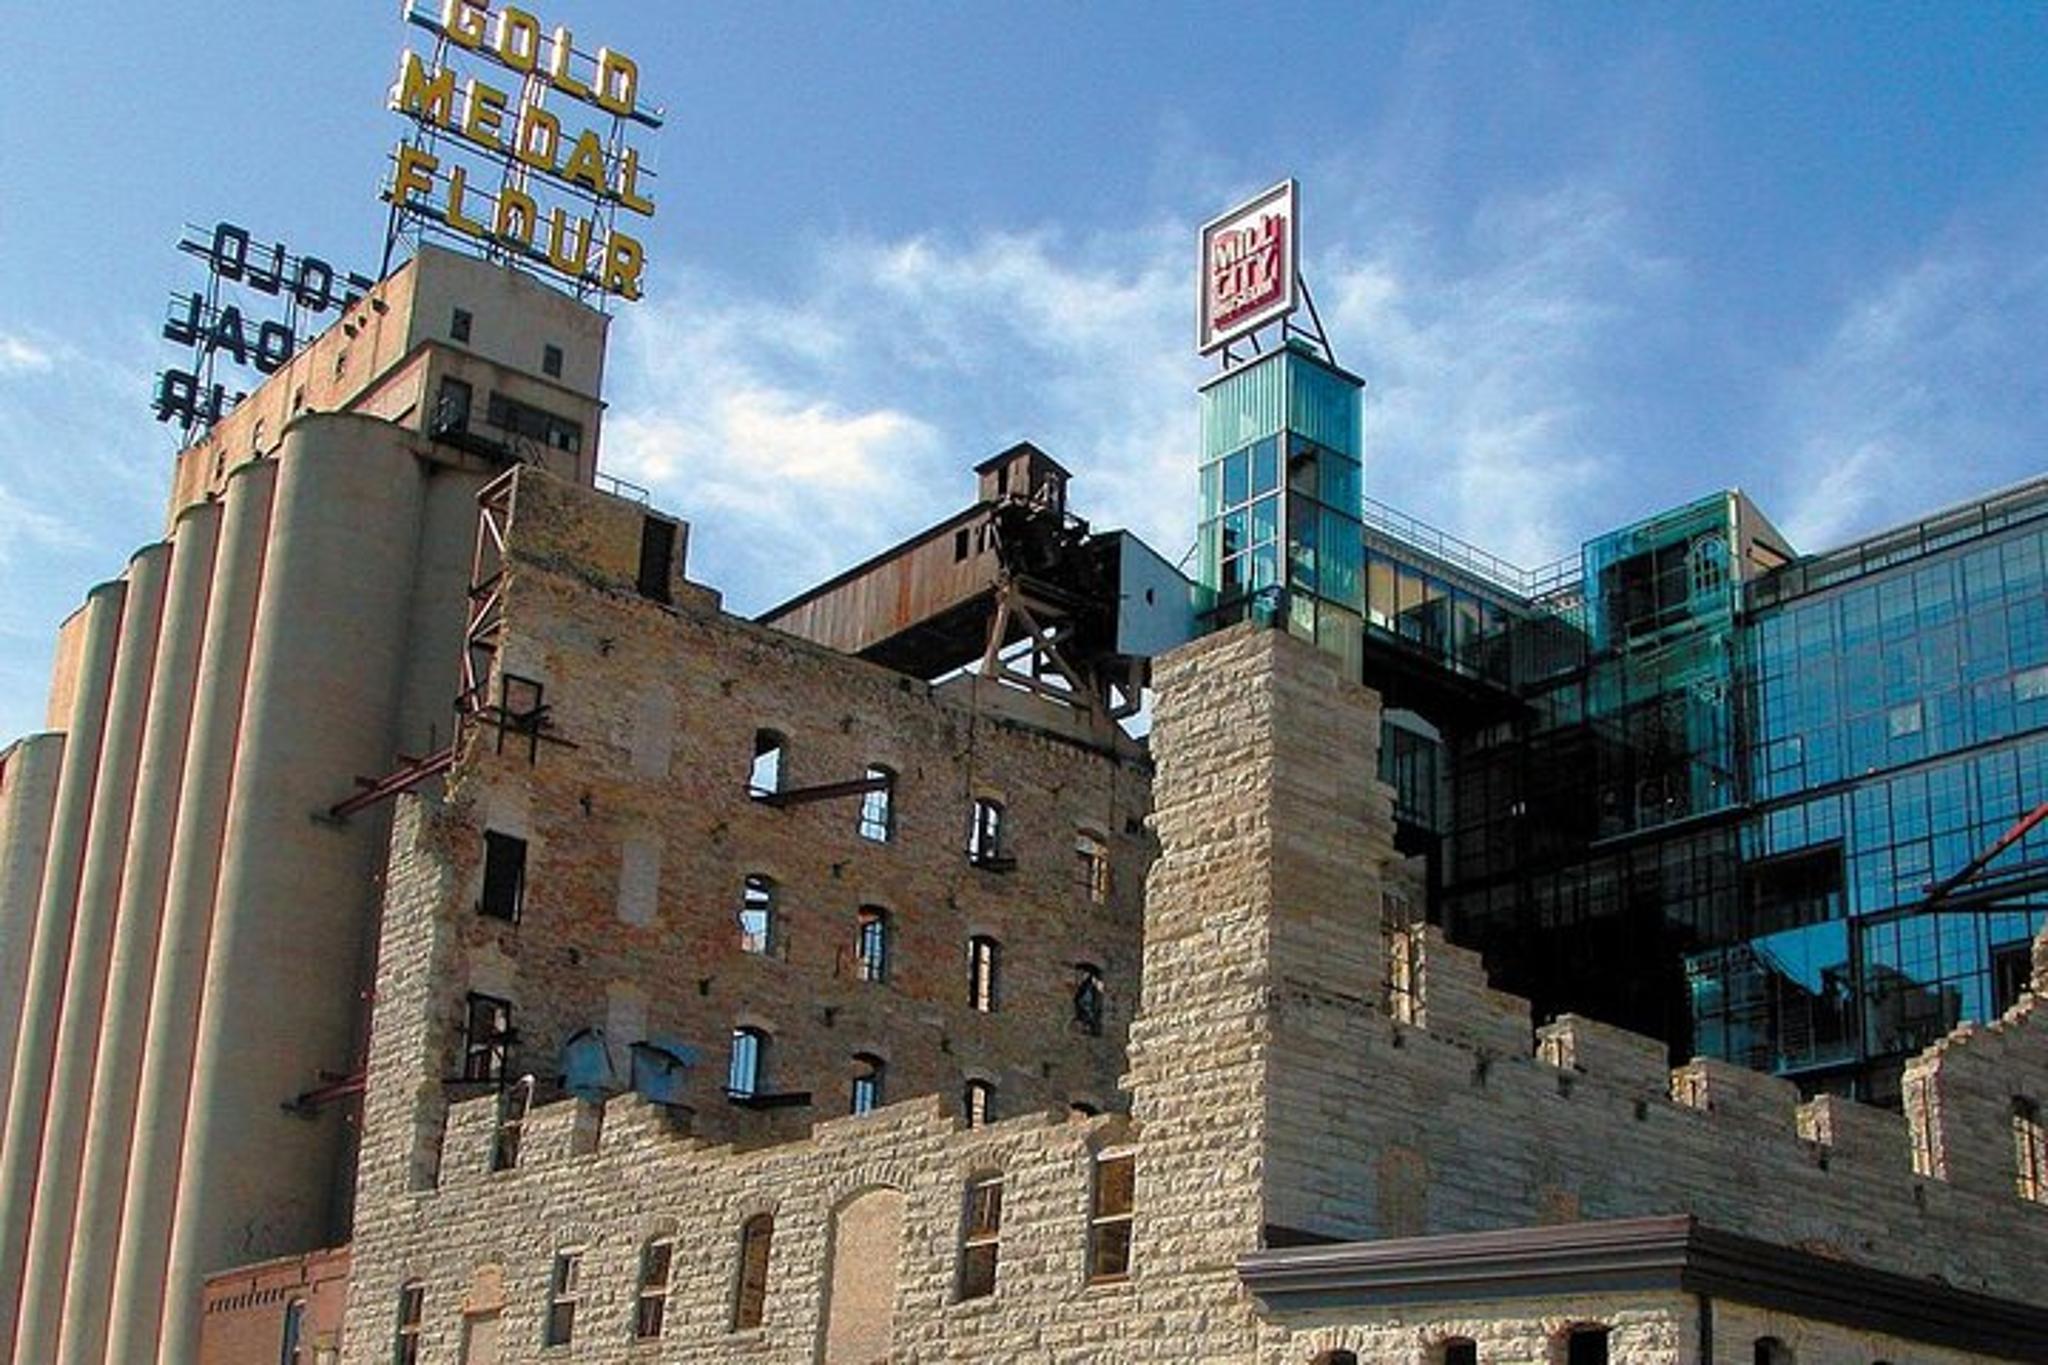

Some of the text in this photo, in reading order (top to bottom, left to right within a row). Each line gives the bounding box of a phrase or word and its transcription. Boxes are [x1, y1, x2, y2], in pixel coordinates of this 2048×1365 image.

[443, 0, 638, 115] GOLD
[397, 49, 655, 217] MEDAL
[393, 141, 645, 301] FLOUR
[1213, 214, 1279, 271] MILL
[1213, 247, 1279, 302] CITY
